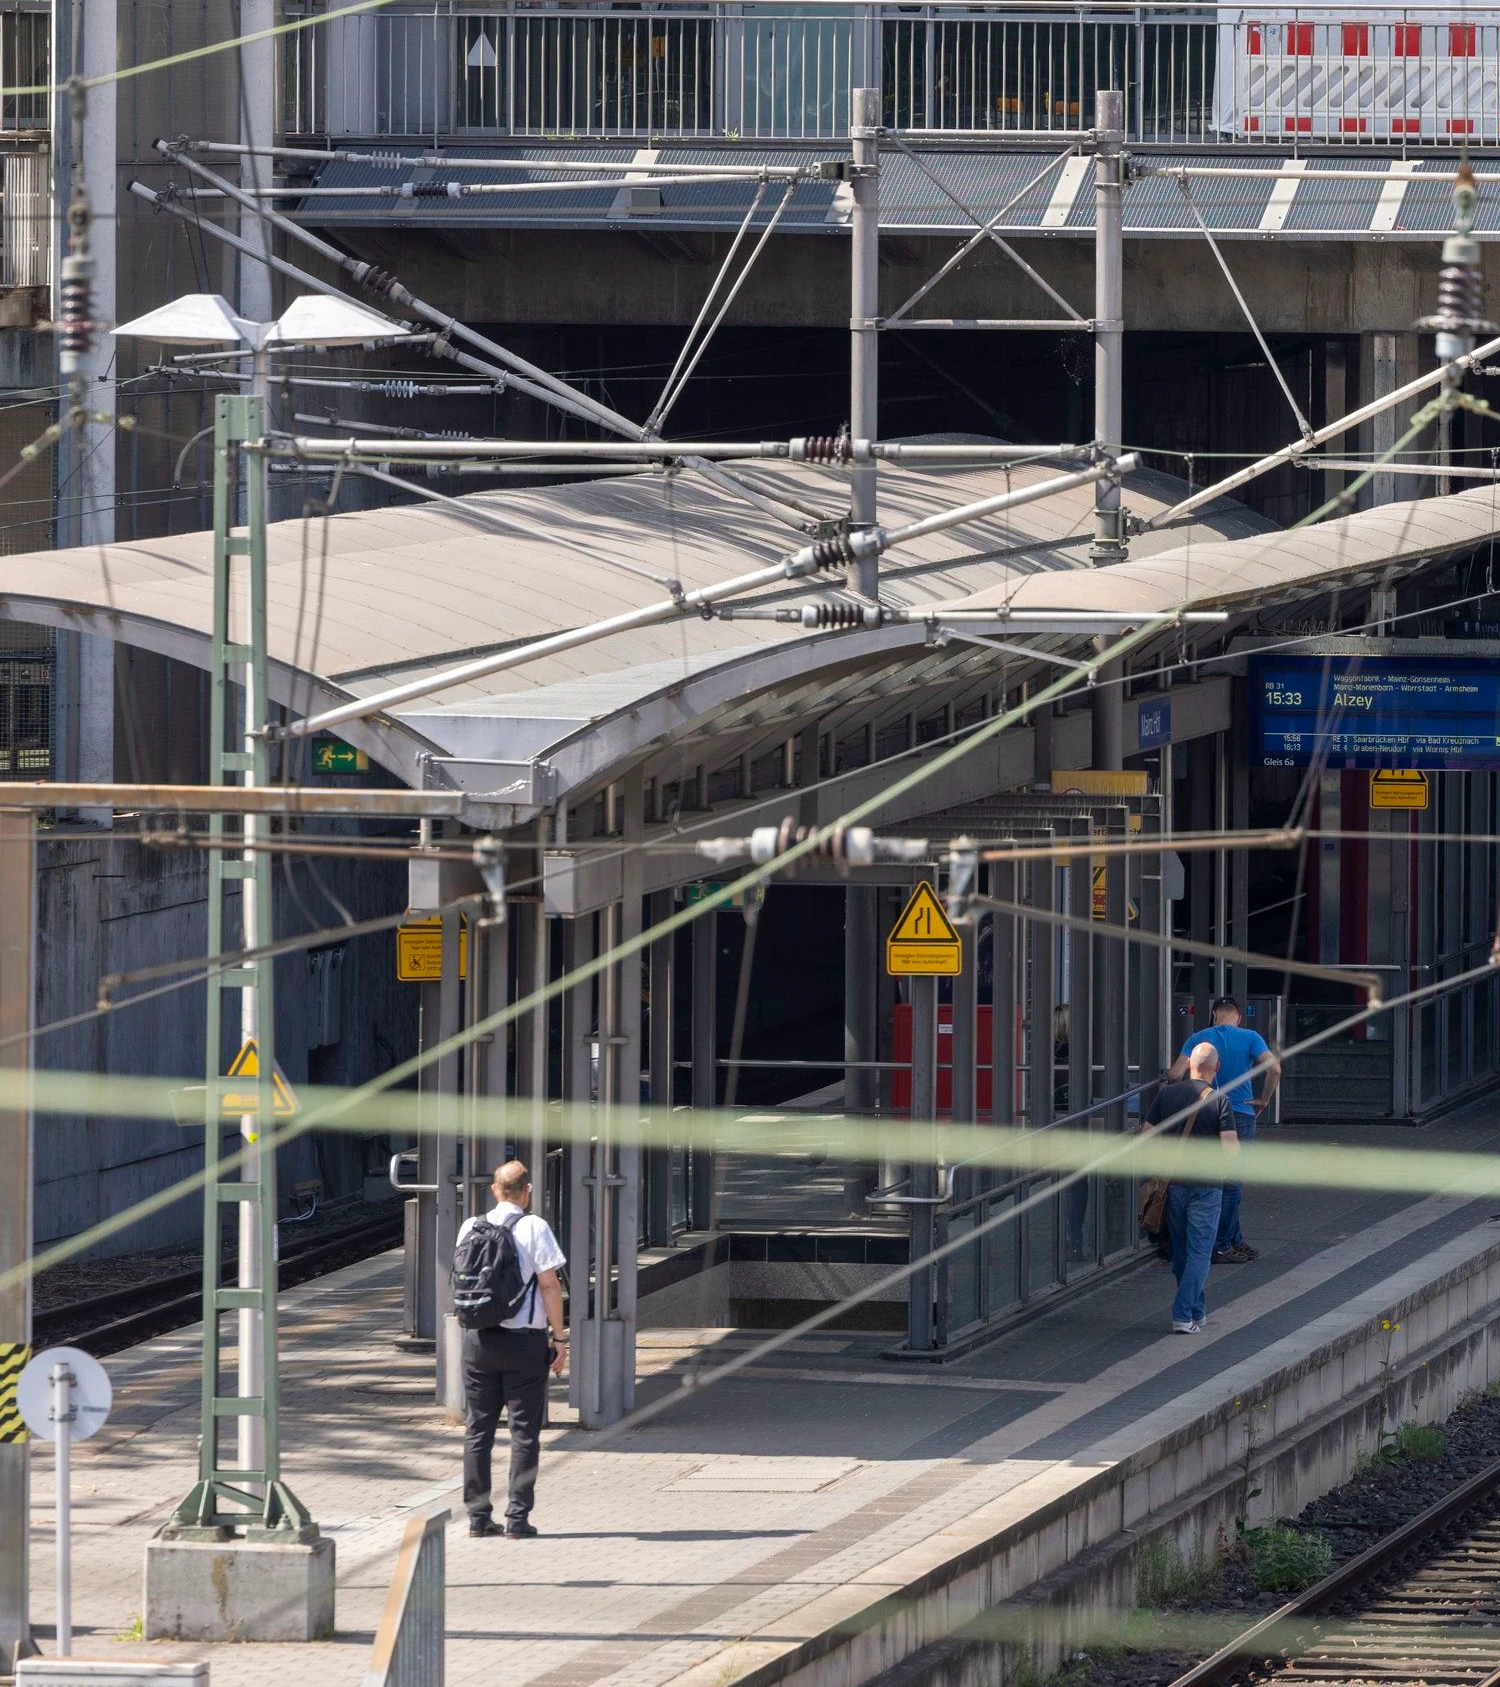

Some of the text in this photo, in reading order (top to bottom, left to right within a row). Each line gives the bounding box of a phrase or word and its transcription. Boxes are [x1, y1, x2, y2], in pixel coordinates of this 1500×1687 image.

[1266, 692, 1302, 705] 15:33
[1334, 693, 1373, 709] Alzey
[1332, 744, 1340, 752] RE
[1264, 758, 1294, 766] Gleis 6a
